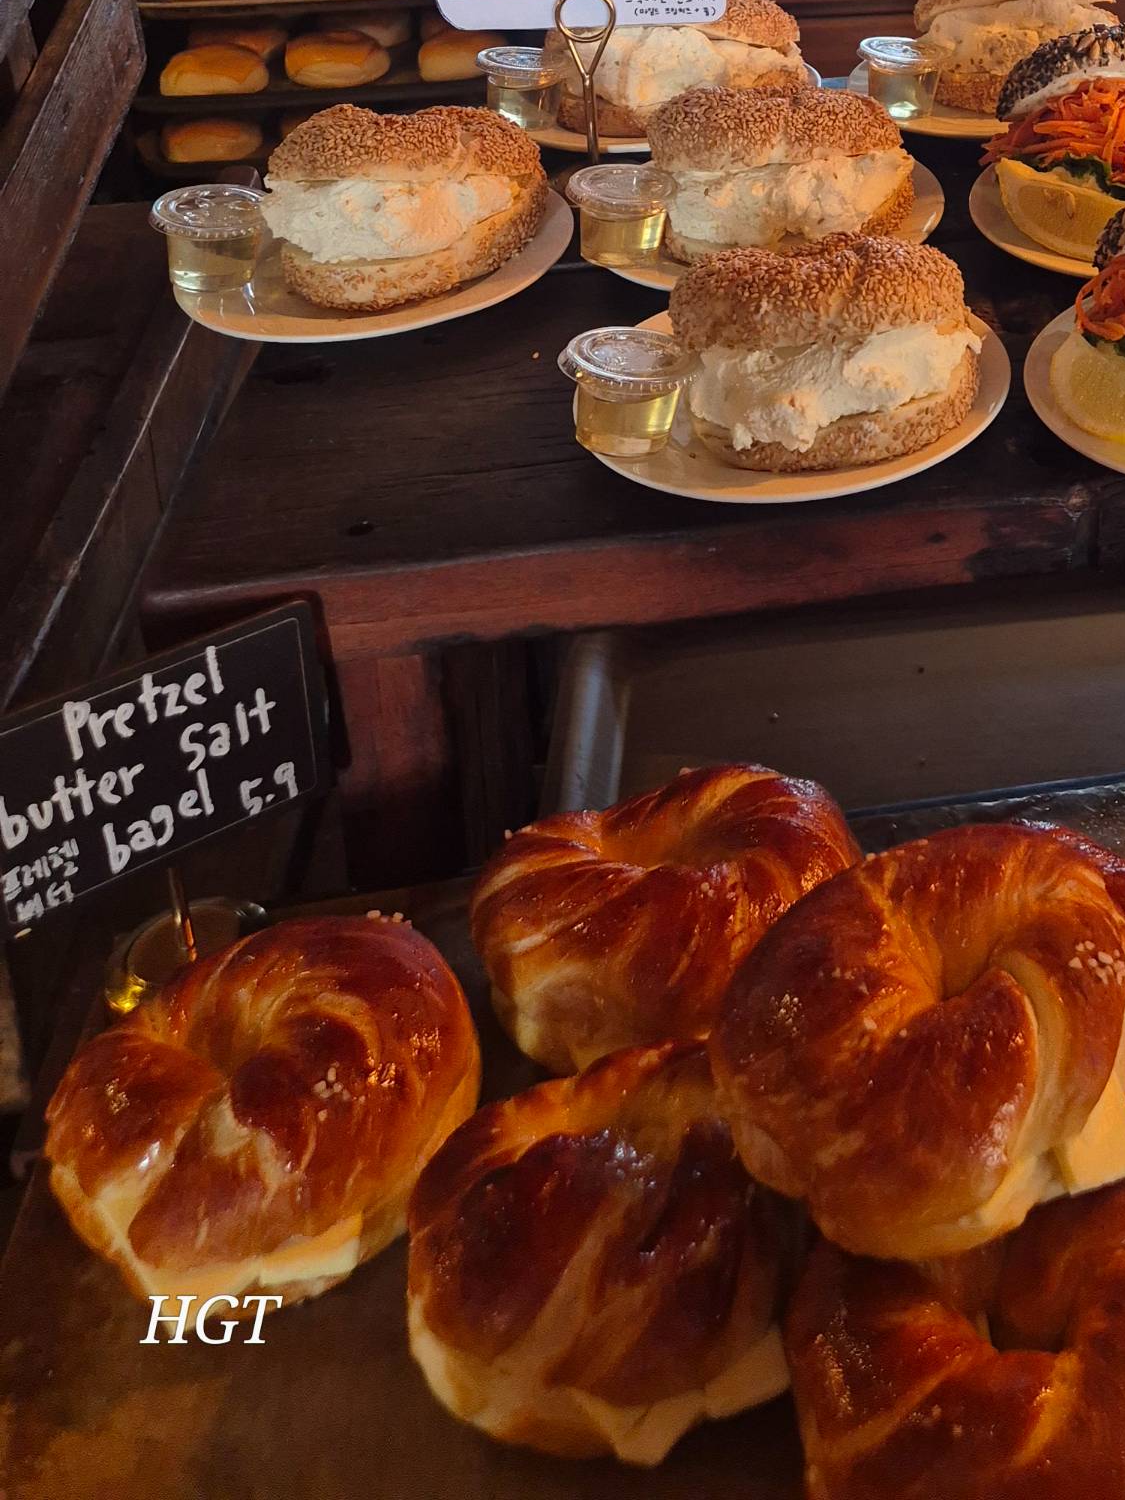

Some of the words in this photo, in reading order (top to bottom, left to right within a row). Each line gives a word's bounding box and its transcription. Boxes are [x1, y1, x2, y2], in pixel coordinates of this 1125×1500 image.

[0, 763, 144, 850] butter
[180, 687, 276, 771] Salt
[103, 768, 214, 874] bagel
[239, 761, 299, 816] 5.9
